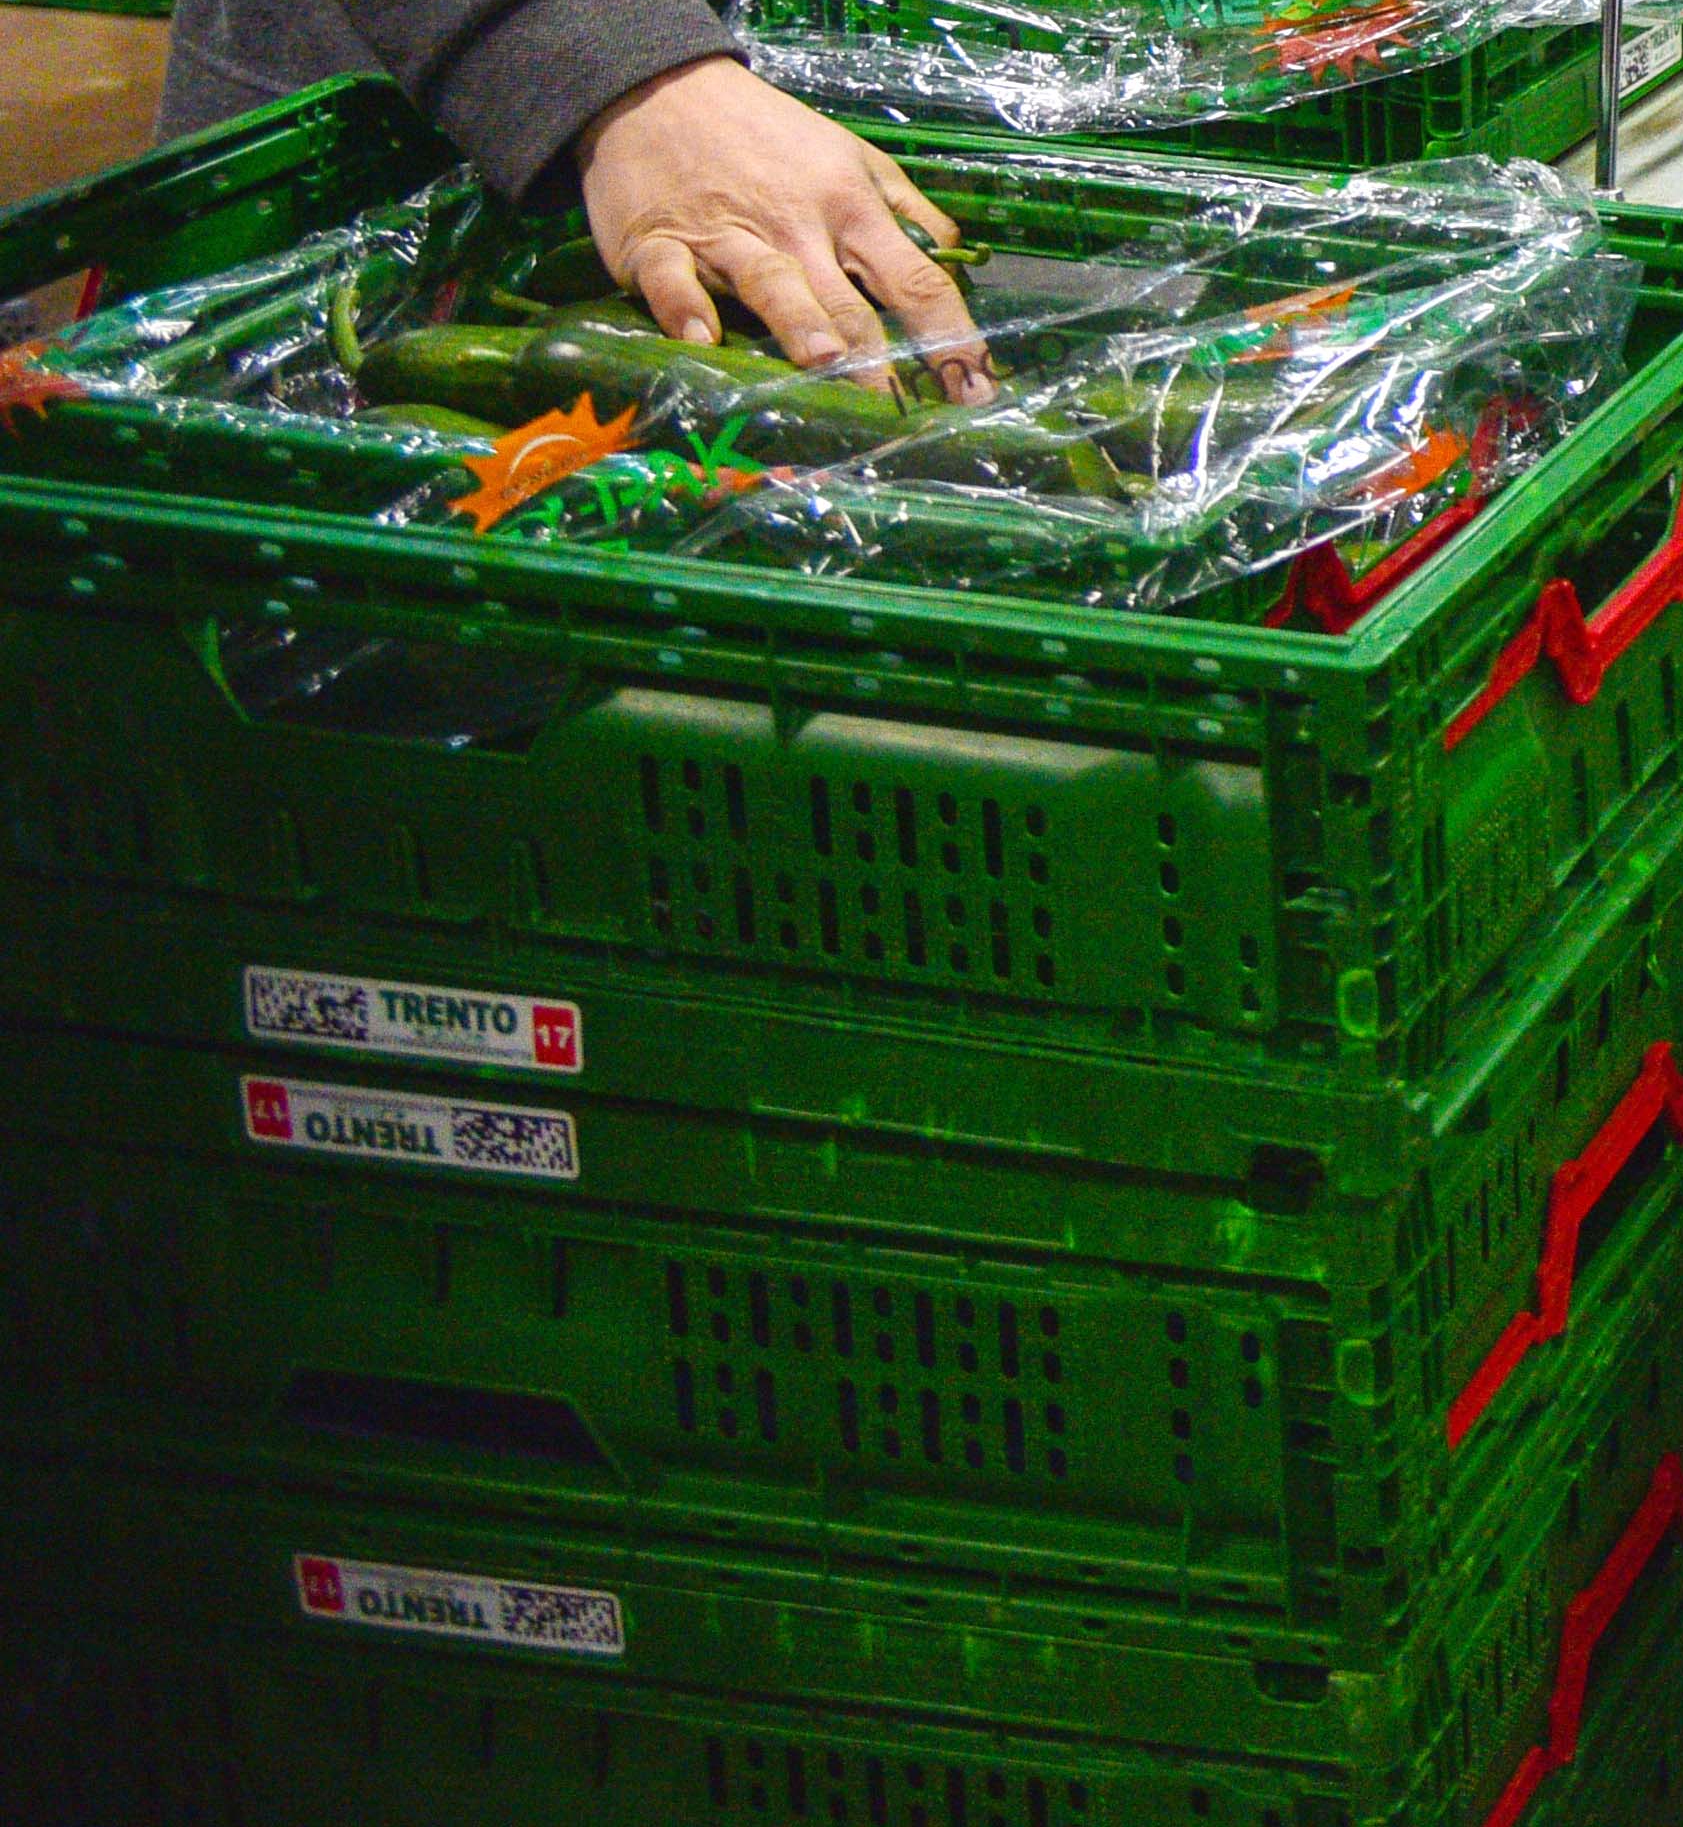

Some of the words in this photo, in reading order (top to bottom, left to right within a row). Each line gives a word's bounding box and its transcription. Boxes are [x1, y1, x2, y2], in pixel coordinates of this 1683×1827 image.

[379, 988, 518, 1036] TRENTO
[536, 1023, 572, 1050] 17
[305, 1111, 441, 1157] TRENTO
[357, 1587, 490, 1630] TRENTO
